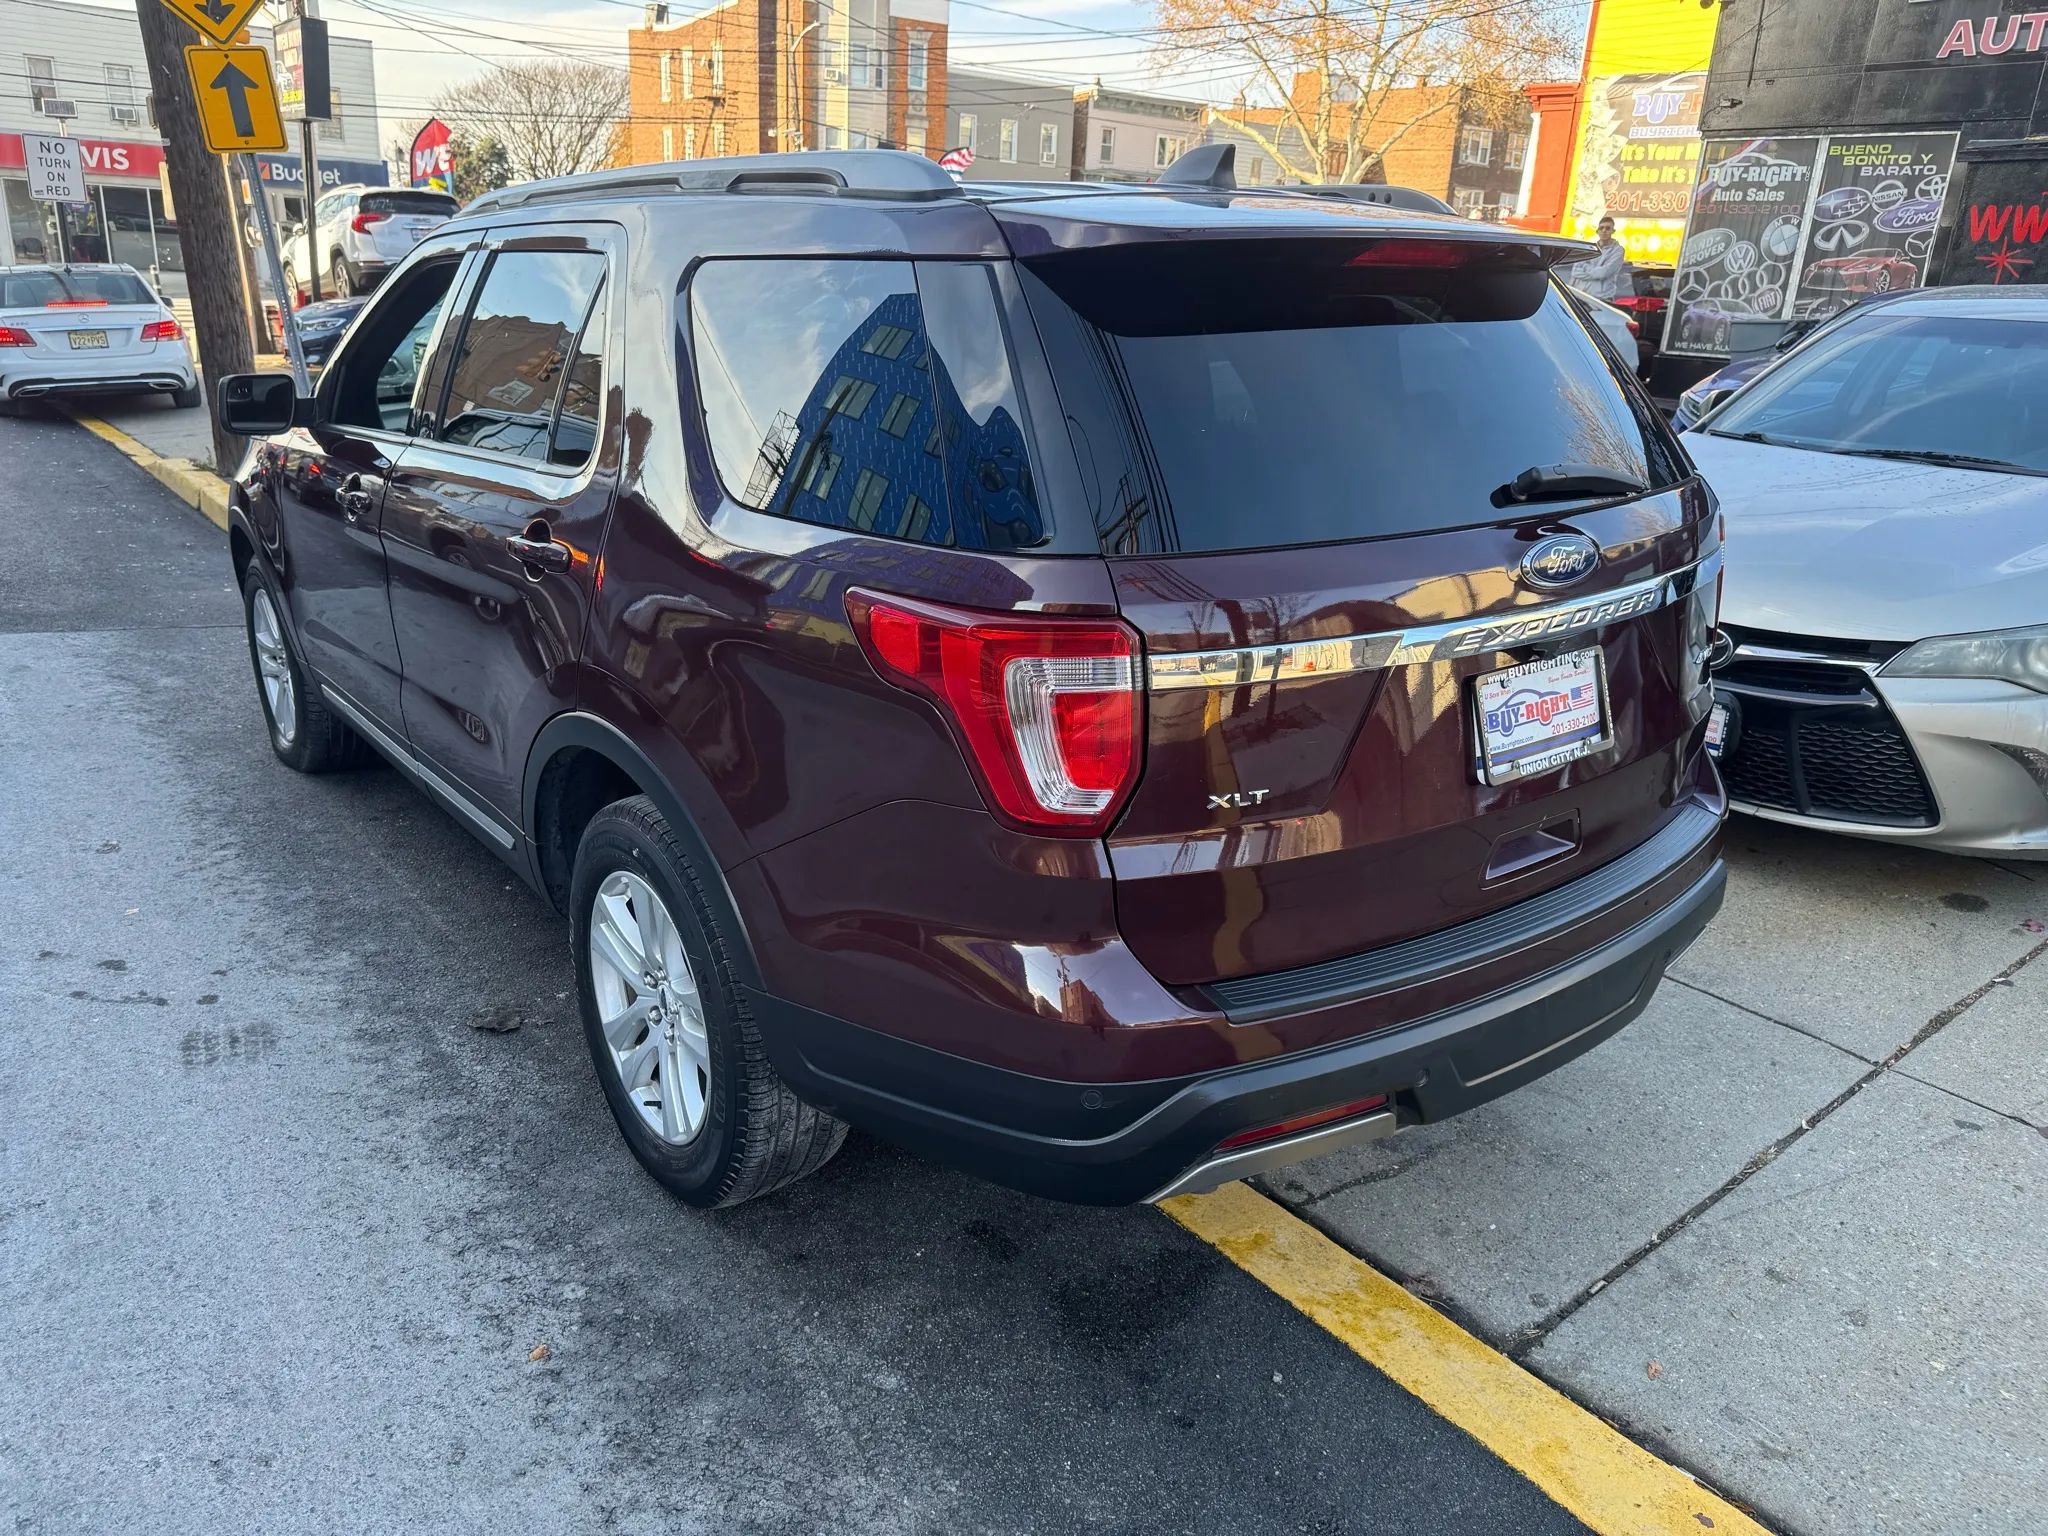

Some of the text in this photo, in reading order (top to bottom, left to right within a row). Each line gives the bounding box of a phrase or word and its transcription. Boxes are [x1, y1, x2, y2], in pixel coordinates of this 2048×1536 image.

[40, 141, 65, 155] NO
[1829, 144, 1892, 155] BUENO
[37, 157, 71, 169] TURN
[81, 146, 129, 171] VIS
[1843, 154, 1933, 166] BONITO Y
[47, 171, 65, 183] ON
[1708, 165, 1807, 188] BUY-RIGHT
[1860, 165, 1937, 176] BARATO
[46, 186, 70, 196] RED
[1712, 187, 1785, 201] Auto Sales
[1872, 191, 1904, 202] NISSAN
[1893, 204, 1940, 227] Ford
[1758, 292, 1776, 312] FIAT
[1674, 341, 1688, 349] WE
[1689, 342, 1712, 351] HAVE
[1547, 546, 1587, 574] Ford
[1454, 592, 1655, 653] EXPLORER
[1488, 693, 1570, 733] BUY-RIGHT
[1551, 711, 1597, 734] 201-330-2100
[1519, 757, 1547, 775] UNION
[1550, 751, 1573, 768] CITY,
[1206, 789, 1269, 810] XLT
